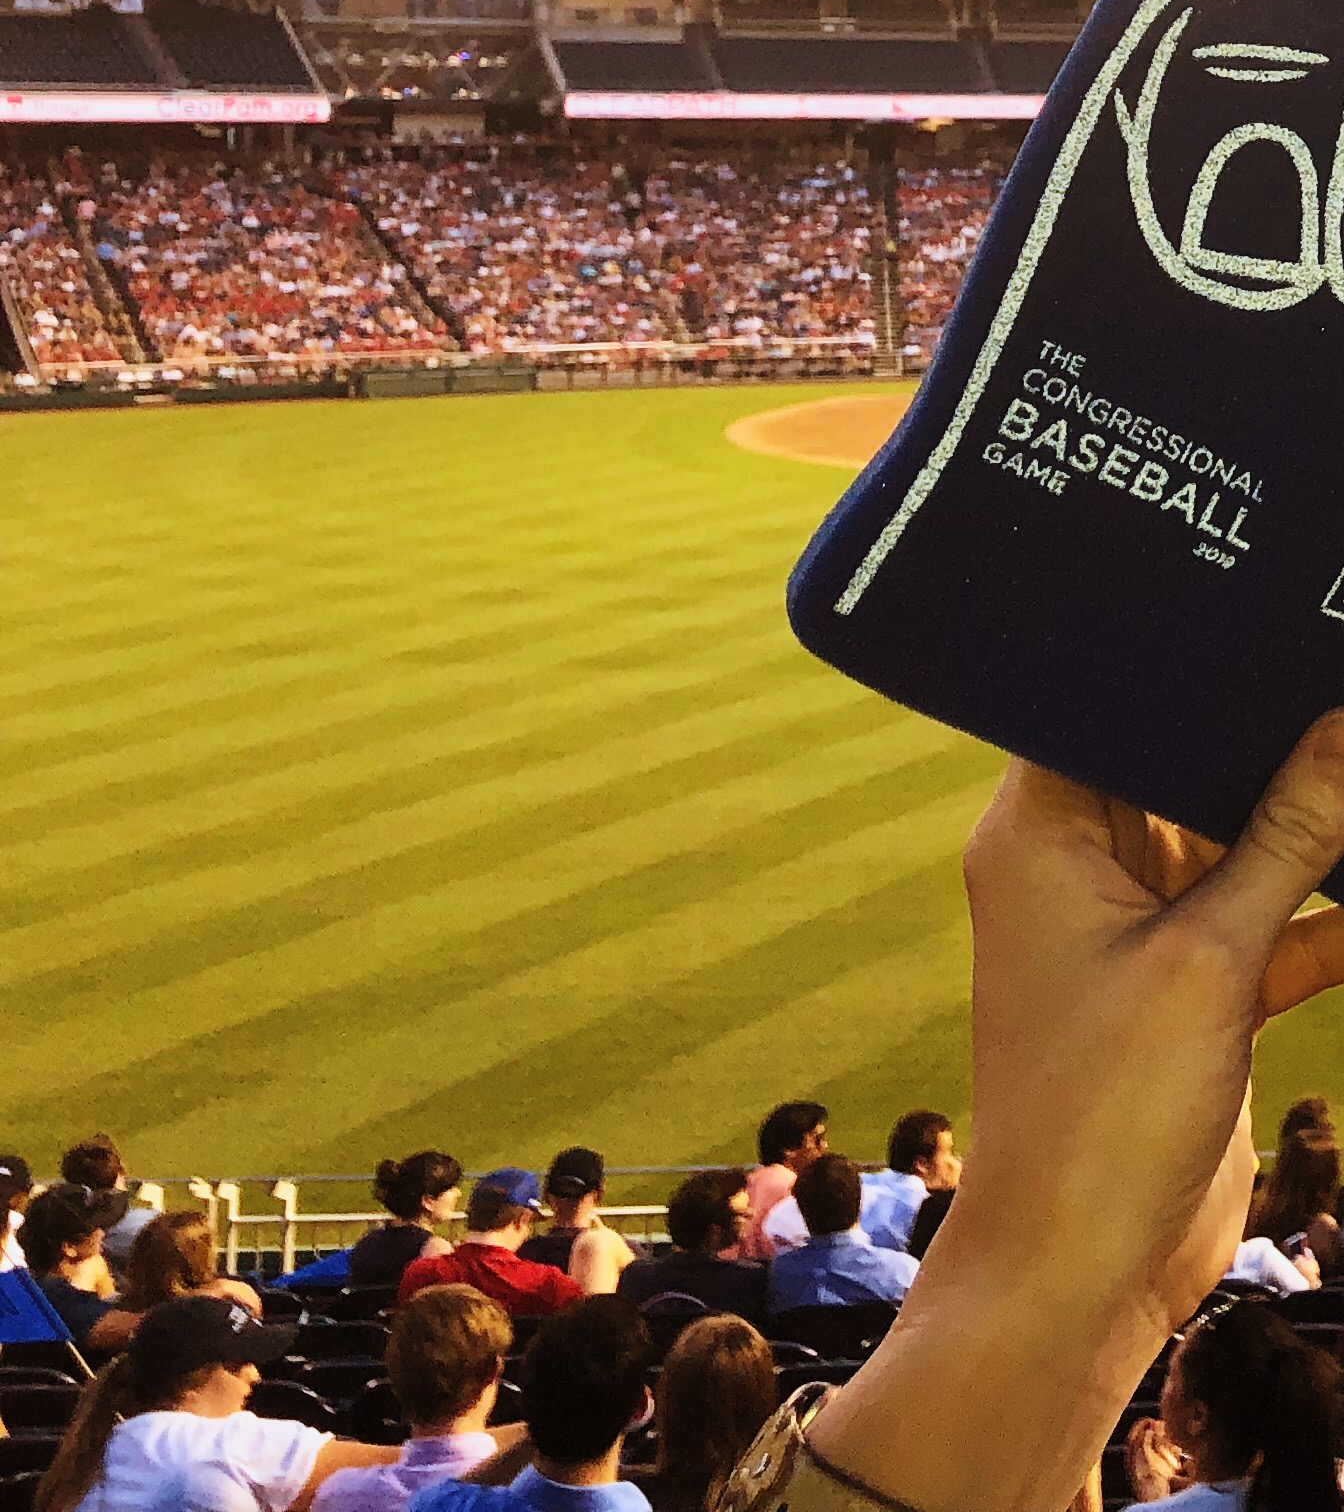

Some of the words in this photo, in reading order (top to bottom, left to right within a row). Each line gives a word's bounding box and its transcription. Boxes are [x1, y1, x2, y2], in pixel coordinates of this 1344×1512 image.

[1039, 340, 1086, 378] THE
[982, 443, 1071, 495] GAME
[998, 398, 1251, 551] BASEBALL
[1023, 368, 1263, 503] CONGRESSIONAL
